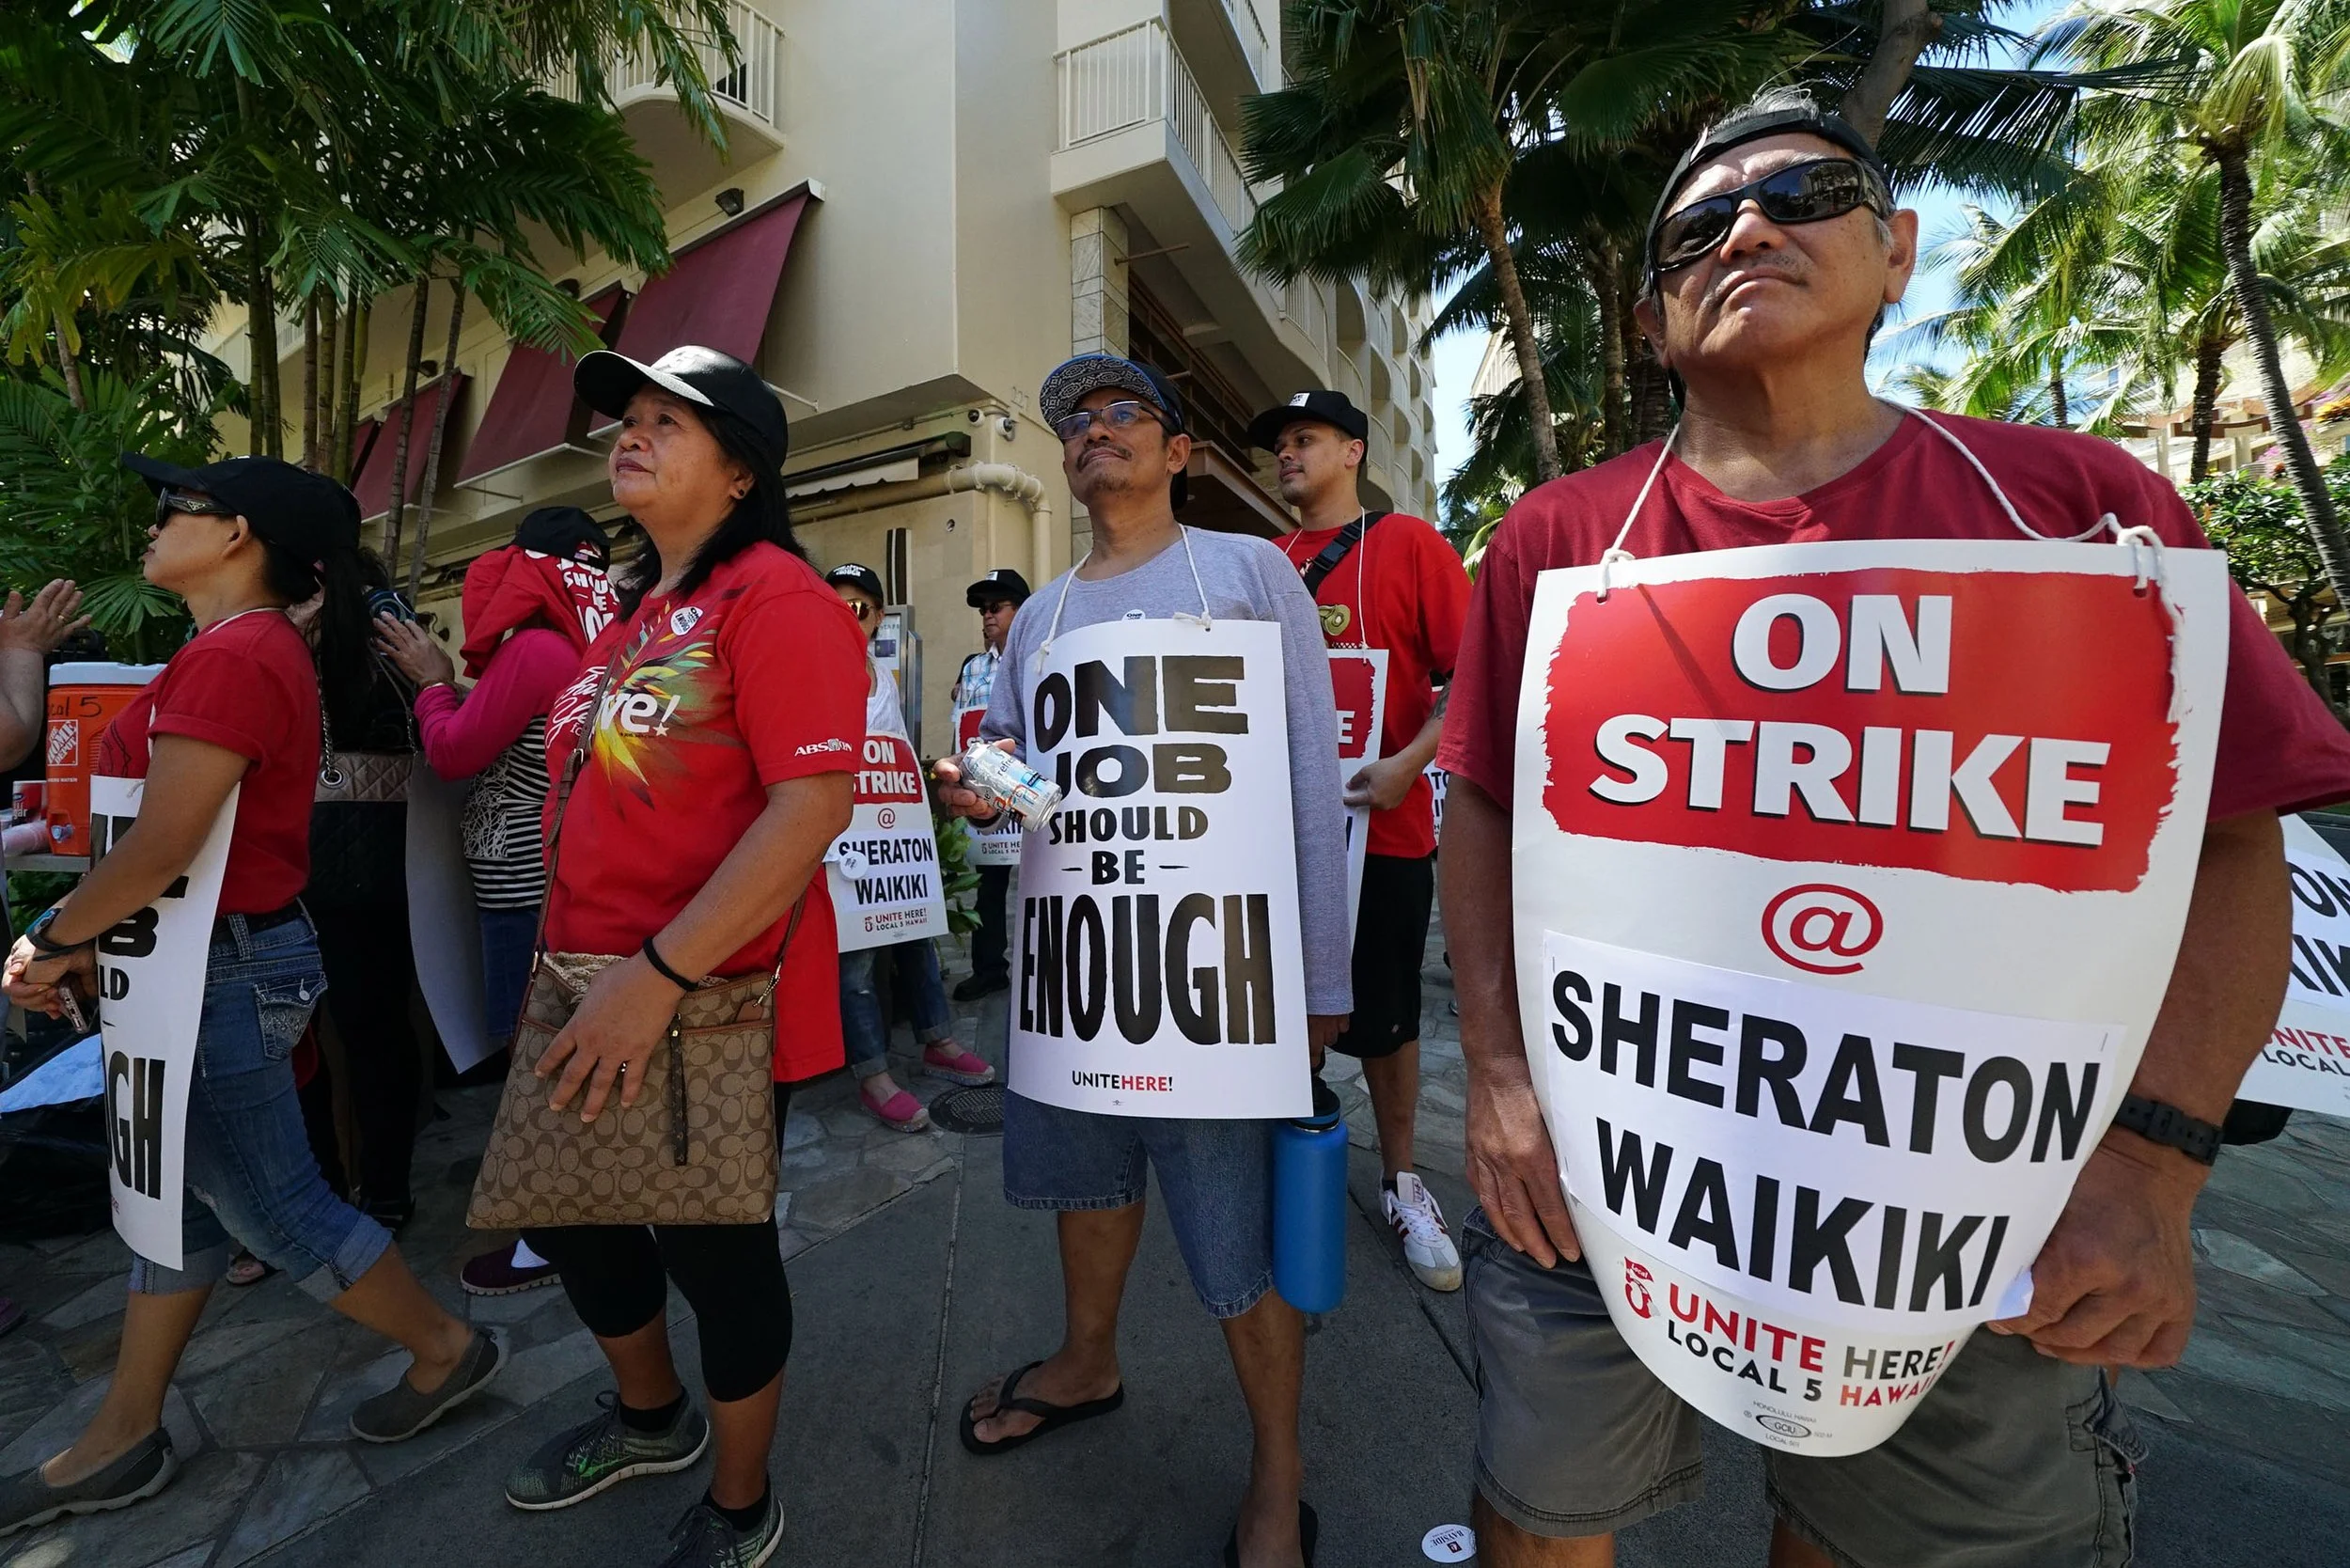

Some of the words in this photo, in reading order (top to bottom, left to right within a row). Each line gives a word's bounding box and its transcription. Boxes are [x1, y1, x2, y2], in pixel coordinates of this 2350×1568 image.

[1732, 594, 1953, 695] ON
[78, 697, 102, 718] 5
[1034, 655, 1249, 754] ONE
[863, 739, 896, 764] ON
[853, 770, 918, 795] TRIKE
[1054, 744, 1232, 801] JOB
[1589, 713, 2112, 847] STRIKE
[877, 808, 896, 829] @
[1049, 806, 1209, 845] SHOULD
[1091, 849, 1146, 886] BE
[854, 873, 929, 905] WAIKIKI
[875, 912, 903, 924] UNITE
[904, 907, 927, 919] HERE!
[876, 919, 899, 932] LOCAL
[1761, 884, 1884, 976] @
[1020, 894, 1277, 1045] ENOUGH
[2269, 1027, 2350, 1059] NITE
[1551, 970, 2101, 1164] SHERATON
[1596, 1117, 2011, 1313] WAIKIKI
[1668, 1282, 1826, 1373] UNITE
[1843, 1340, 1956, 1380] HERE!
[1668, 1319, 1787, 1394] LOCAL
[1803, 1377, 1823, 1402] 5
[1765, 1433, 1787, 1445] LOCAL
[1774, 1421, 1796, 1435] GCIU
